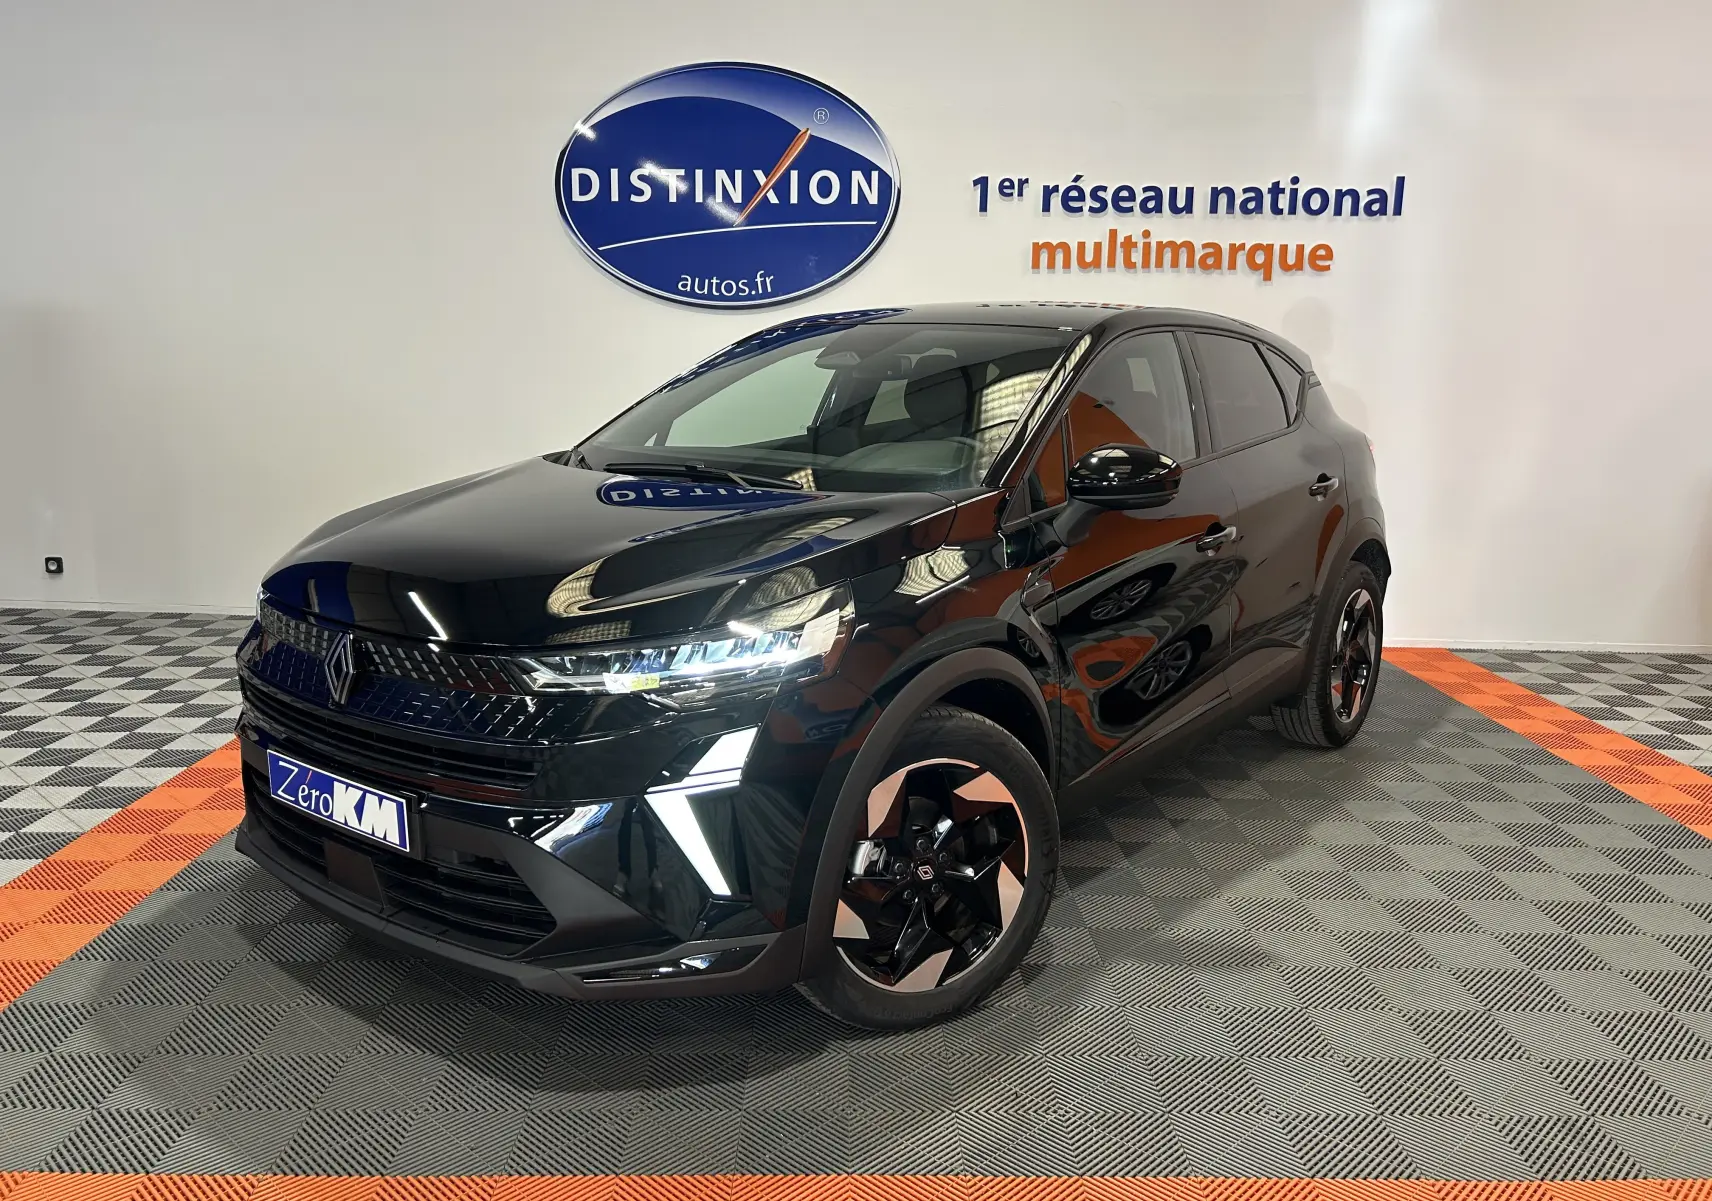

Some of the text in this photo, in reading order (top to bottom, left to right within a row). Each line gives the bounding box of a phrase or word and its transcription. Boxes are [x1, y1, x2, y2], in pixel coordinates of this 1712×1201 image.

[571, 167, 879, 205] DISTINXION
[1041, 174, 1195, 215] réseau
[1209, 176, 1406, 217] national
[1031, 228, 1334, 282] multimarque
[677, 270, 775, 297] autos.fr
